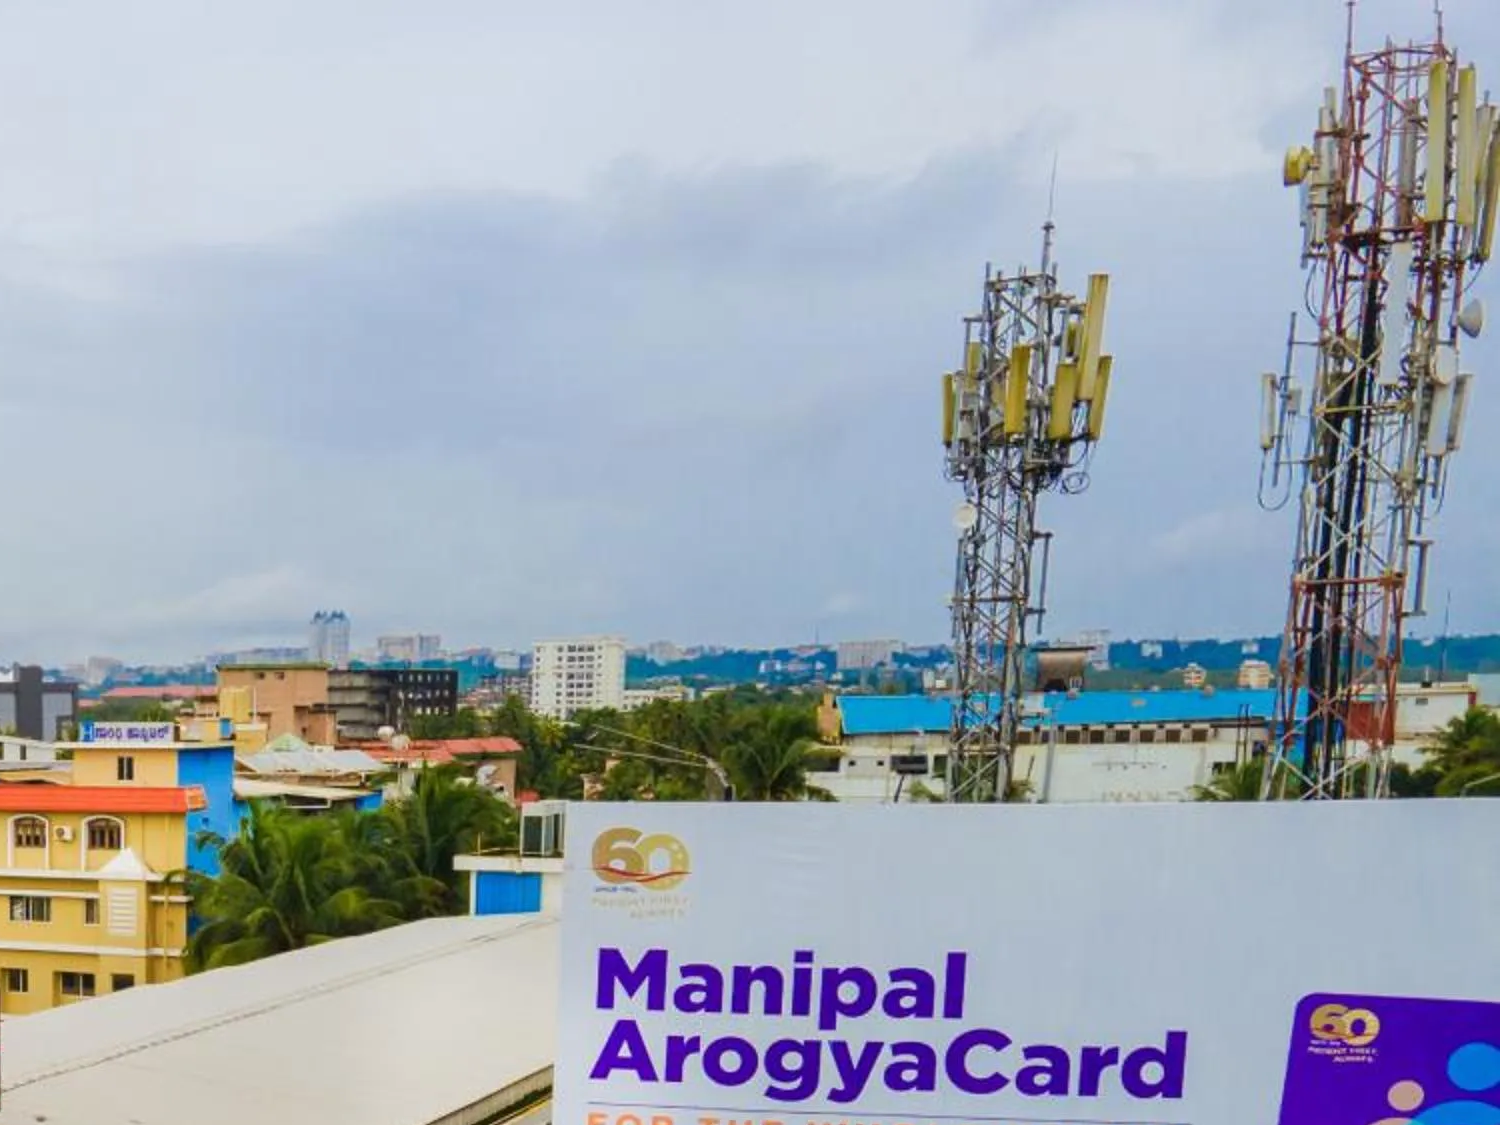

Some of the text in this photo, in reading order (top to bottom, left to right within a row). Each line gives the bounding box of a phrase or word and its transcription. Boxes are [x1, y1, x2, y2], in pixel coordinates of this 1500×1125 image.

[592, 827, 690, 890] 60
[596, 947, 967, 1031] Manipal
[1310, 1003, 1380, 1046] 60
[589, 1019, 1188, 1103] ArogyaCard
